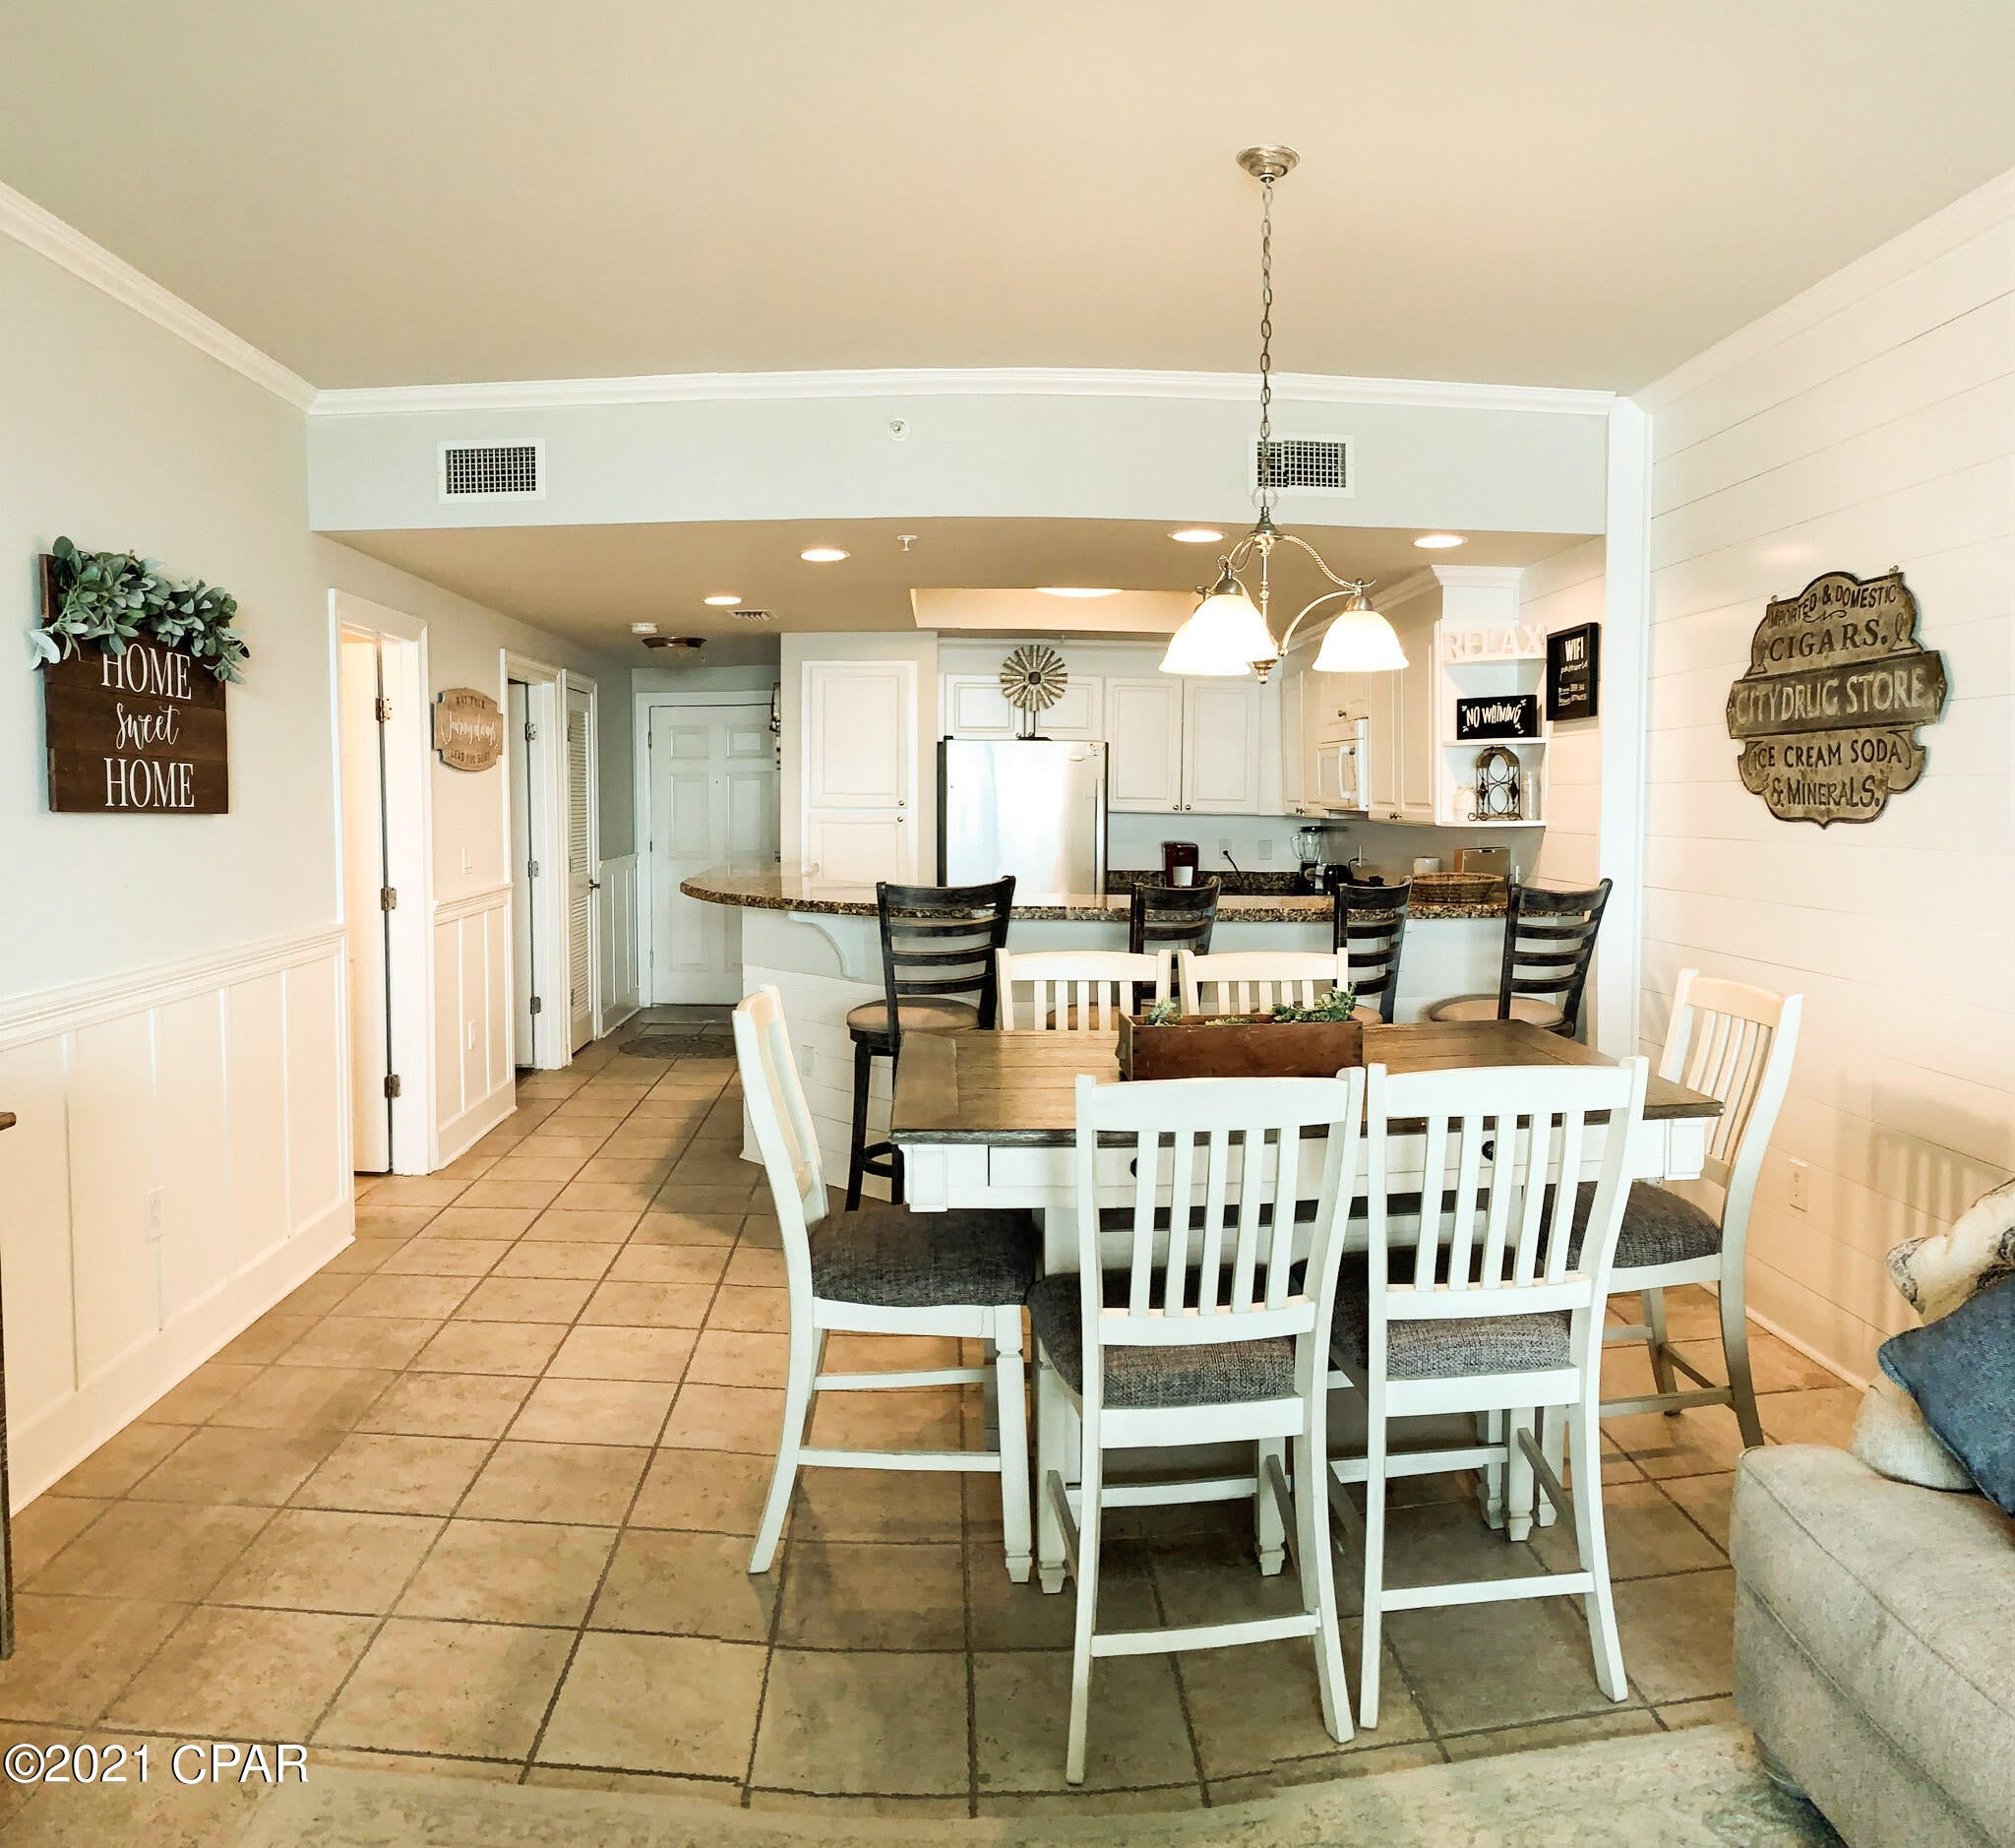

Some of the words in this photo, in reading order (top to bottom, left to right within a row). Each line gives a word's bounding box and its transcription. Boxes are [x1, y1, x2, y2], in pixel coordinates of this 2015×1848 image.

[1822, 585, 1832, 605] &
[1836, 584, 1897, 609] DOMESTIC
[1443, 622, 1549, 662] RELAX
[1564, 636, 1585, 662] WIFI
[1770, 618, 1888, 662] CIGARS.
[101, 643, 192, 701] HOME
[1735, 690, 1779, 726] CITY
[1780, 678, 1840, 721] DRUG
[1845, 666, 1925, 714] STORE
[1466, 706, 1481, 728] NO
[1752, 745, 1776, 771] ICE
[1784, 741, 1842, 769] CREAM
[1850, 737, 1903, 765] SODA
[103, 756, 195, 809] HOME
